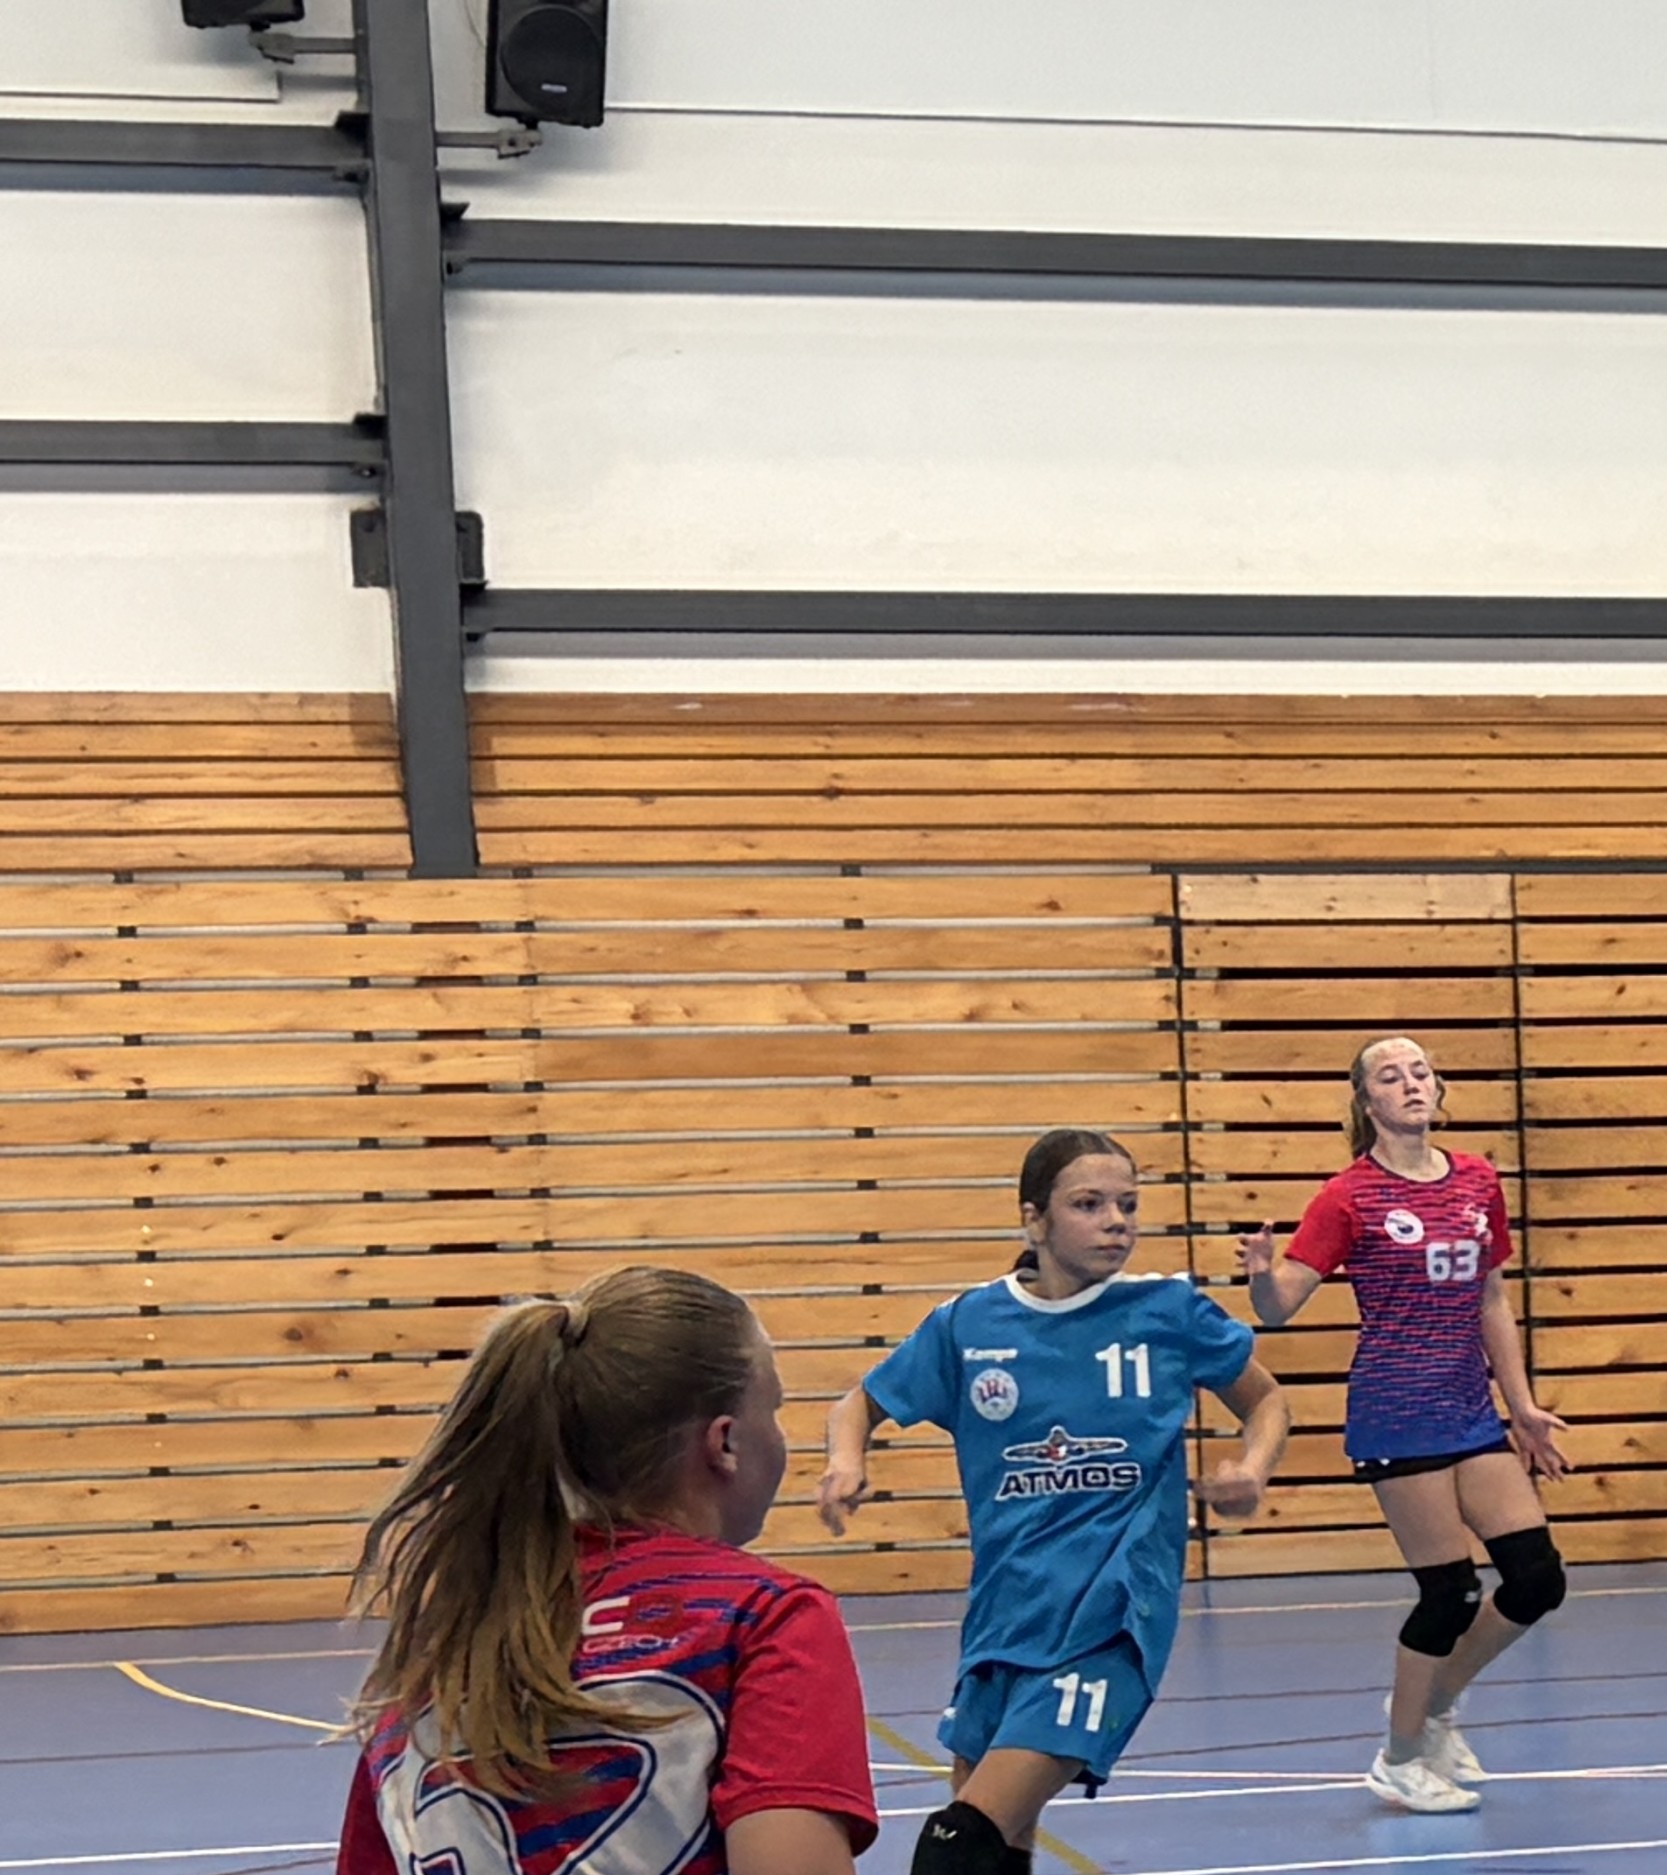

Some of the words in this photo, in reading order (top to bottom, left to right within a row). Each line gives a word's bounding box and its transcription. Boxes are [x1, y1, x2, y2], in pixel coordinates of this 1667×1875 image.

[1425, 1239, 1480, 1282] 63
[1095, 1342, 1151, 1398] 11
[995, 1462, 1142, 1501] ATMOS
[1052, 1671, 1107, 1733] 11
